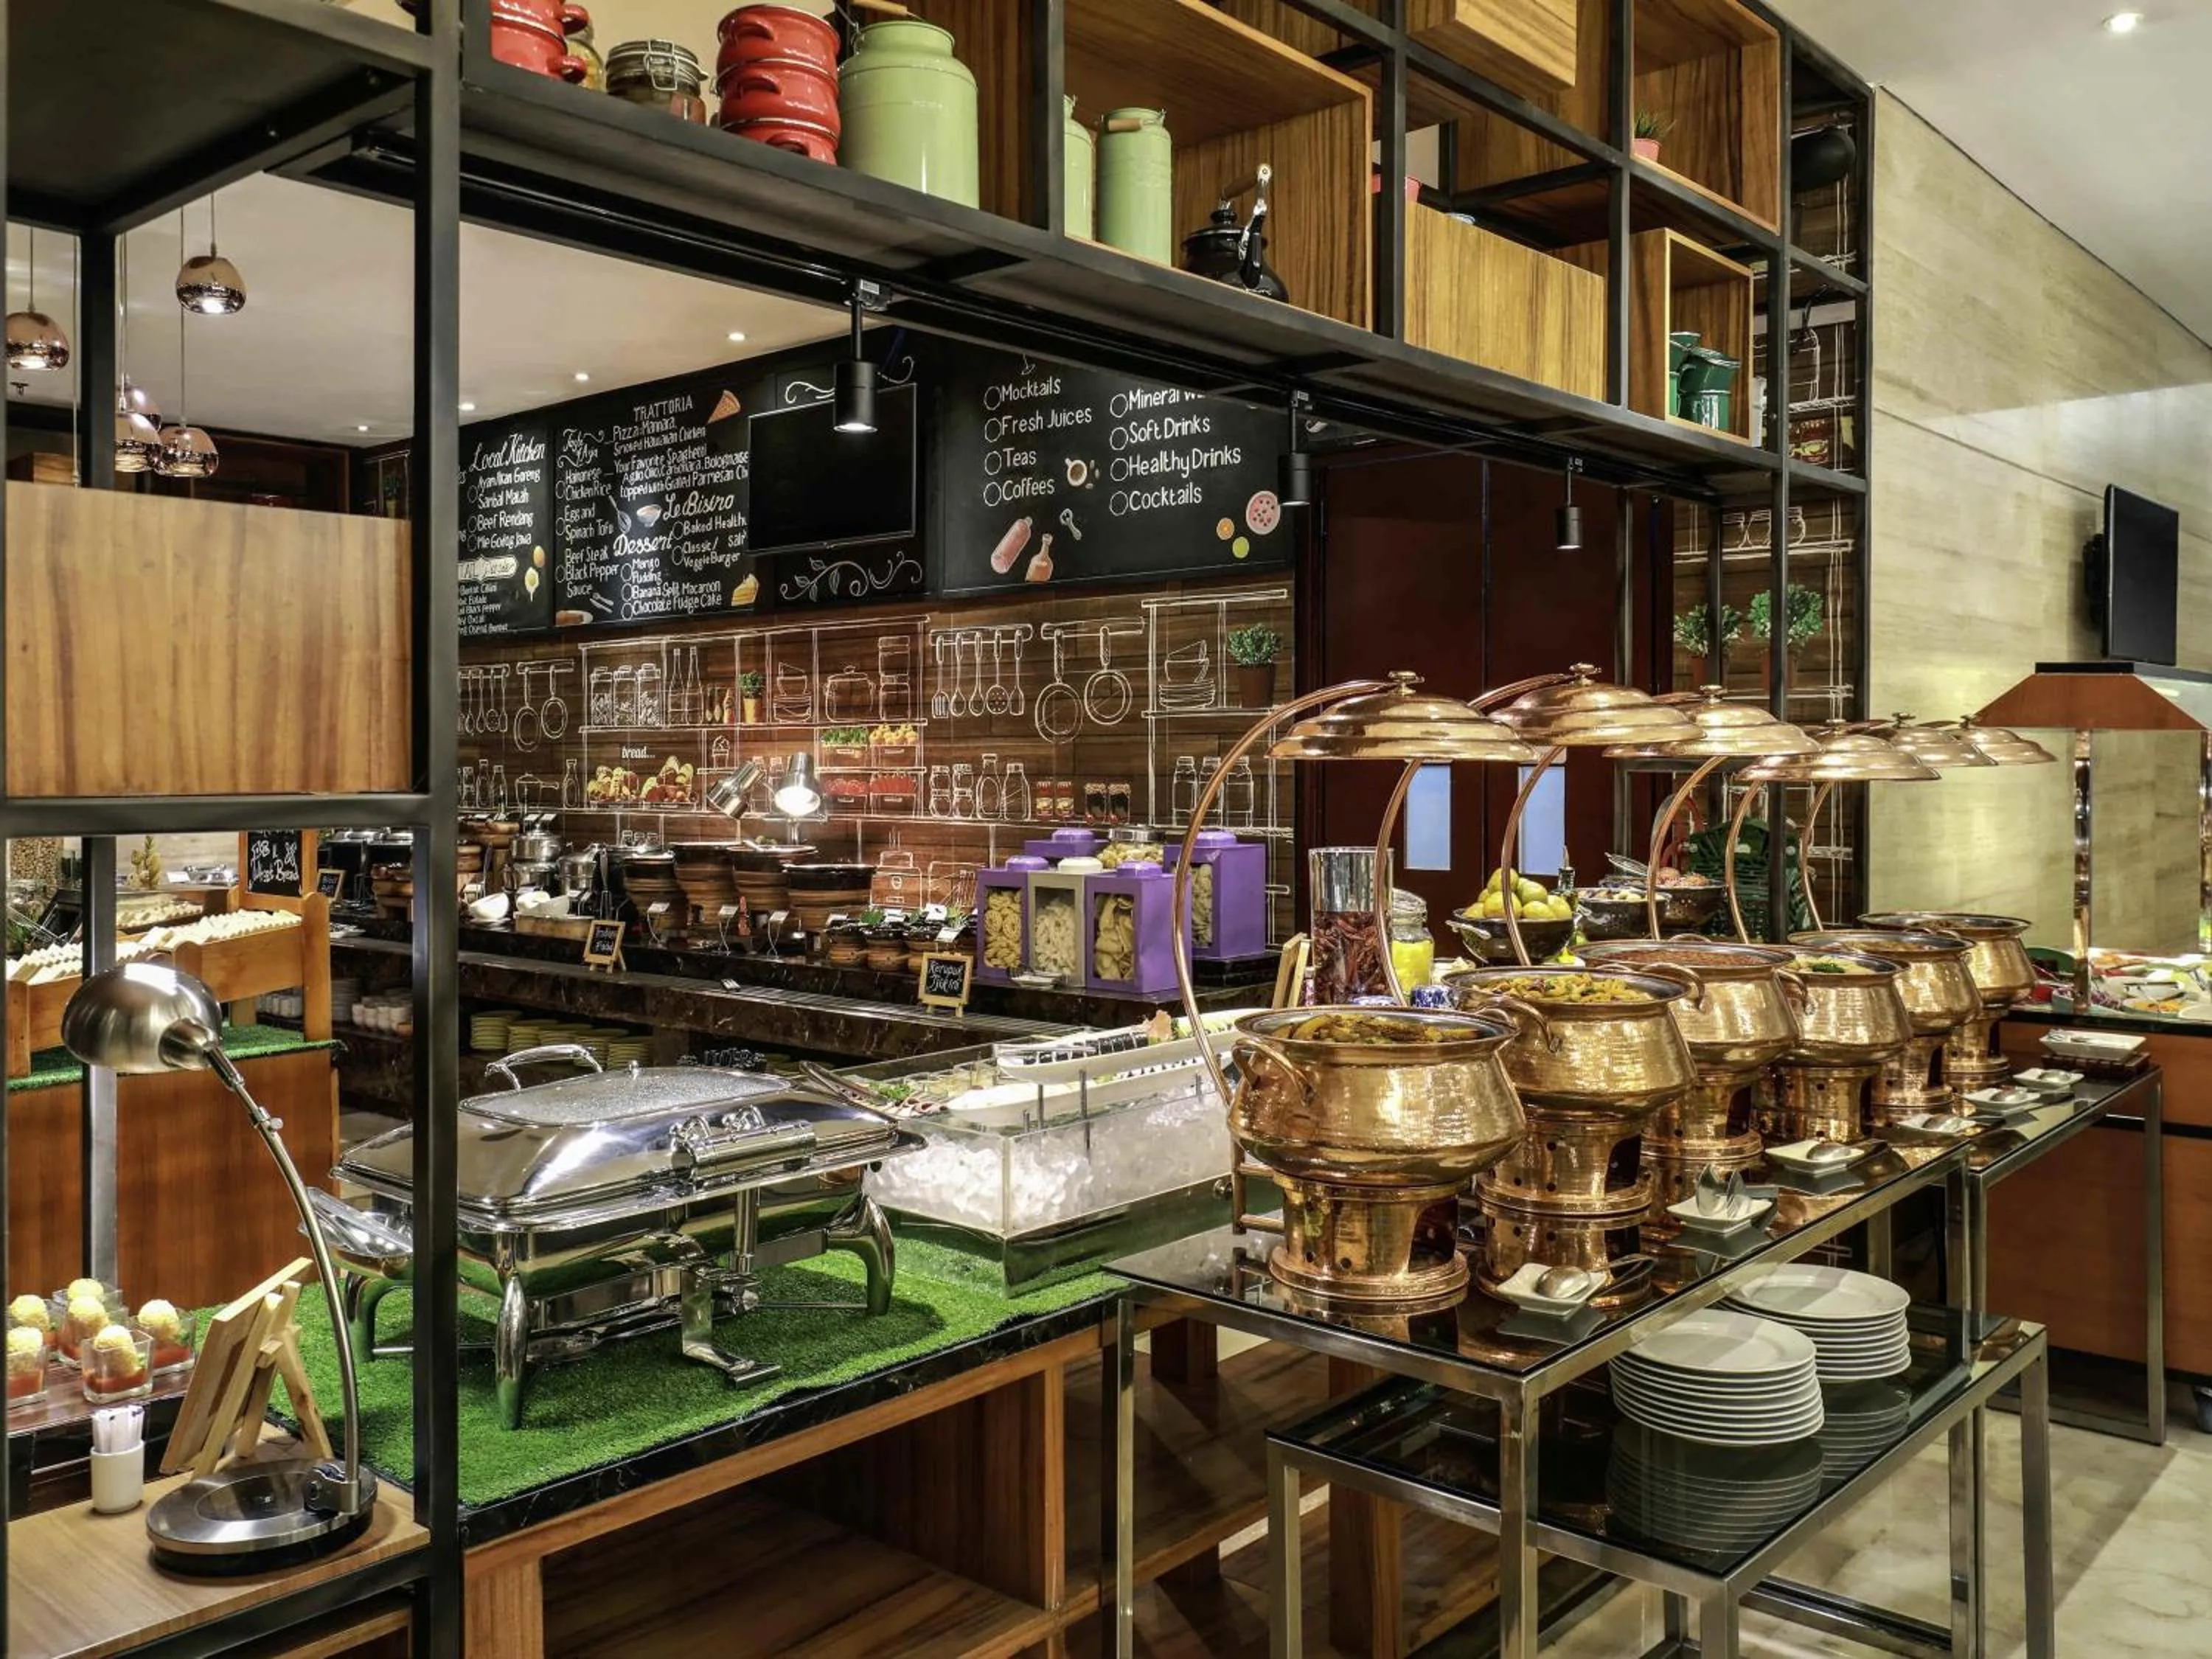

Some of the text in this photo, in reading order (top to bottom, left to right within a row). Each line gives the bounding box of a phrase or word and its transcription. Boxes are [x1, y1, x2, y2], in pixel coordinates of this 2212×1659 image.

[1002, 377, 1061, 403] Mocktails
[1129, 387, 1180, 410] Mineral
[633, 395, 693, 422] TRATTORIA
[1001, 406, 1092, 437] Fresh Juices
[1130, 414, 1210, 443] Soft Drinks
[679, 426, 706, 442] Chicken
[469, 433, 545, 470] Local Kitchen
[614, 459, 630, 474] Your
[667, 443, 707, 465] Spaghetti
[1003, 448, 1037, 468] Teas
[1129, 445, 1242, 478] Healthy Drinks
[620, 482, 648, 501] topped
[649, 479, 664, 493] with
[665, 476, 691, 490] Grated
[692, 469, 734, 487] Parmesan
[622, 470, 644, 486] Aglio
[566, 480, 611, 501] Chicken Rice
[1002, 478, 1054, 501] Coffees
[1129, 482, 1203, 512] Cocktails
[565, 502, 595, 522] Egg and
[663, 490, 735, 521] Le Bistro
[477, 510, 534, 531] Beef Rendang
[683, 518, 713, 536] Baked
[566, 523, 594, 545] Spinach
[613, 531, 674, 557] Dessert
[565, 545, 609, 564] Beef Steak
[633, 558, 660, 571] Mango
[684, 552, 740, 572] Veggie Burger
[566, 562, 619, 582] Black Pepper
[632, 571, 661, 585] Pudding
[566, 580, 592, 598] Sauce
[633, 585, 661, 599] Banana
[633, 593, 723, 616] Chocolate Fudge Cake
